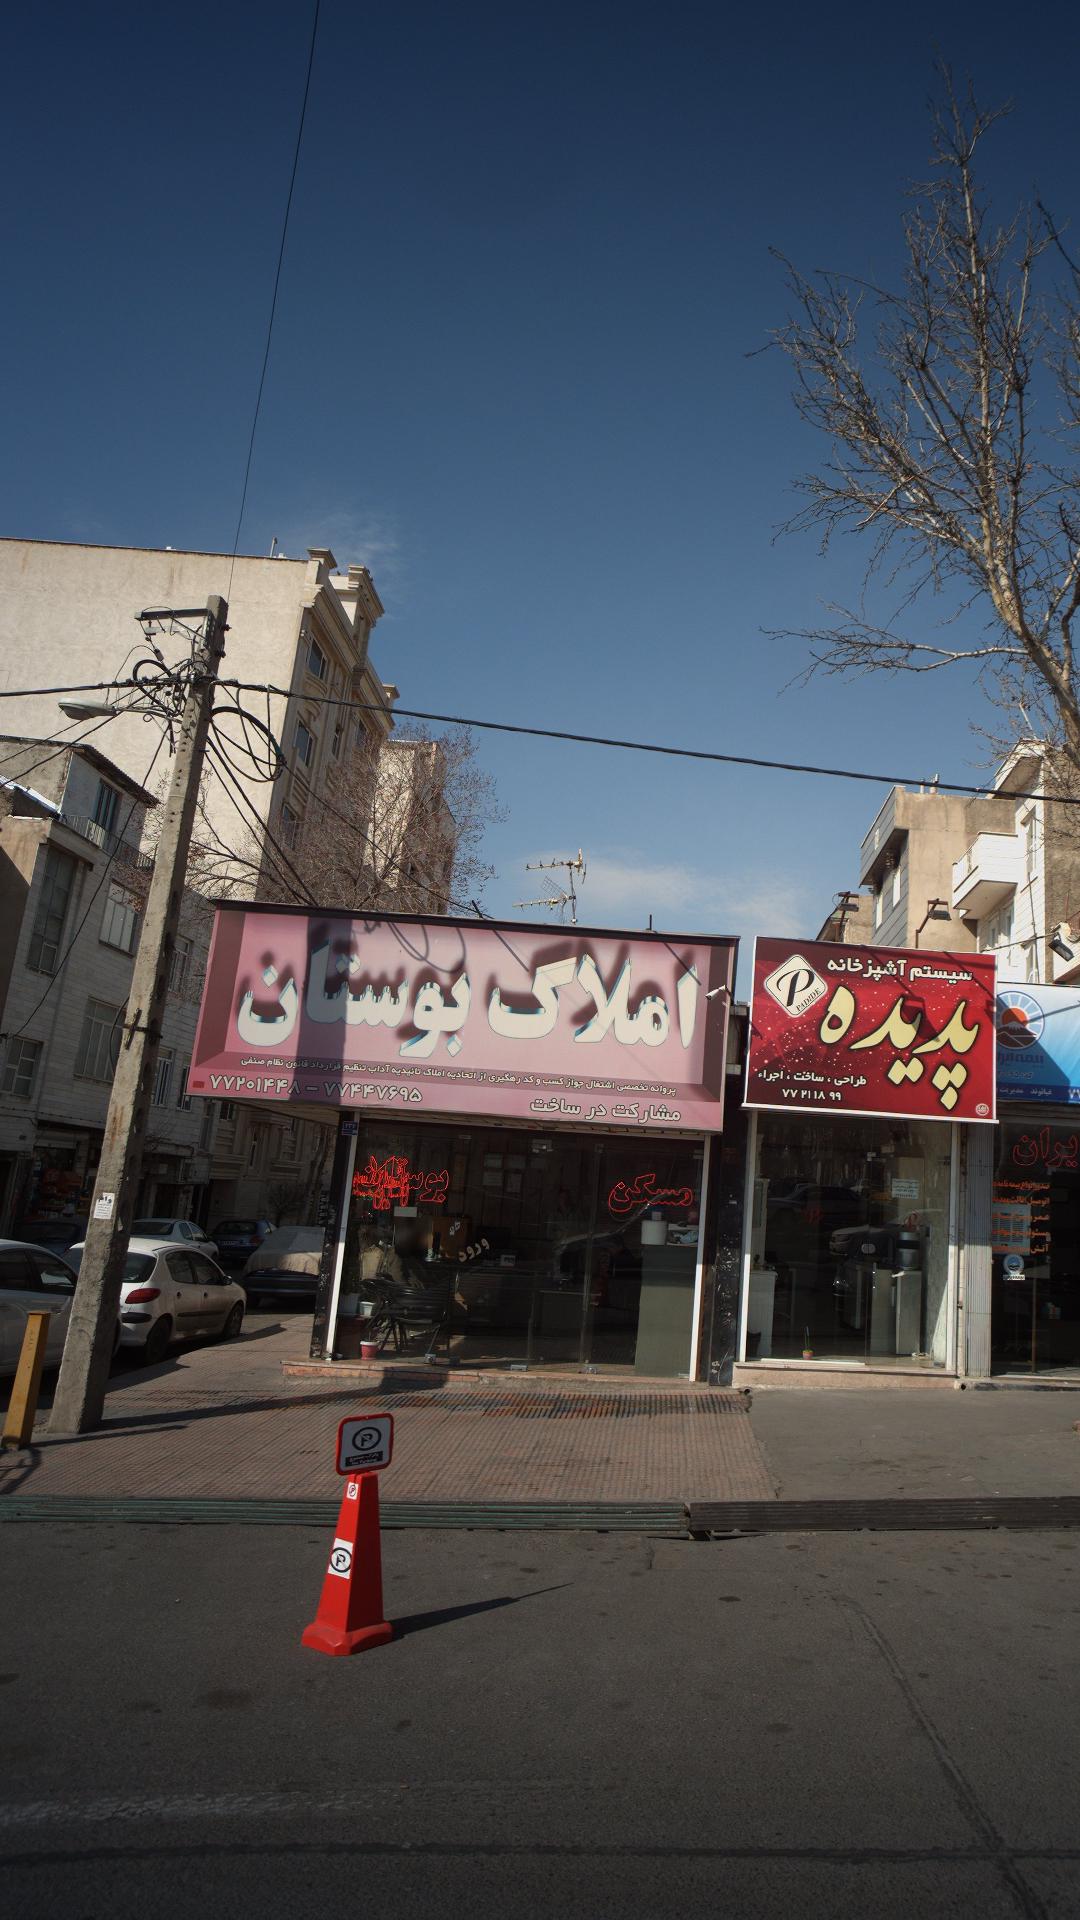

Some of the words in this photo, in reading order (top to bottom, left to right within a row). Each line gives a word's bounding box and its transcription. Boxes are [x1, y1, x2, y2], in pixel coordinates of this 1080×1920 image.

[827, 957, 907, 982] آشپزخانه
[909, 965, 973, 984] سیستم
[237, 937, 472, 1059] بوستان
[488, 953, 698, 1049] املاک
[795, 987, 821, 1012] PADIDE
[819, 985, 980, 1111] پدیده
[240, 1056, 265, 1067] صنفی
[266, 1057, 284, 1068] نظام
[285, 1058, 309, 1069] قانون
[342, 1061, 367, 1072] تنظیم
[369, 1063, 390, 1074] آداب
[422, 1067, 445, 1078] املاک
[447, 1070, 477, 1080] اتحادیه
[478, 1072, 486, 1081] از
[488, 1073, 521, 1084] رهگیری
[523, 1075, 535, 1084] کد
[793, 1071, 824, 1082] ساخت
[542, 1077, 564, 1087] کسب
[565, 1078, 585, 1088] جواز
[586, 1079, 615, 1089] اشتغال
[834, 1075, 867, 1087] طراحی
[617, 1082, 649, 1093] تخصصی
[651, 1084, 677, 1097] پروانه
[529, 1097, 582, 1115] ساخت
[585, 1104, 606, 1119] در
[612, 1103, 681, 1123] مشارکت
[608, 1173, 694, 1213] مسکن
